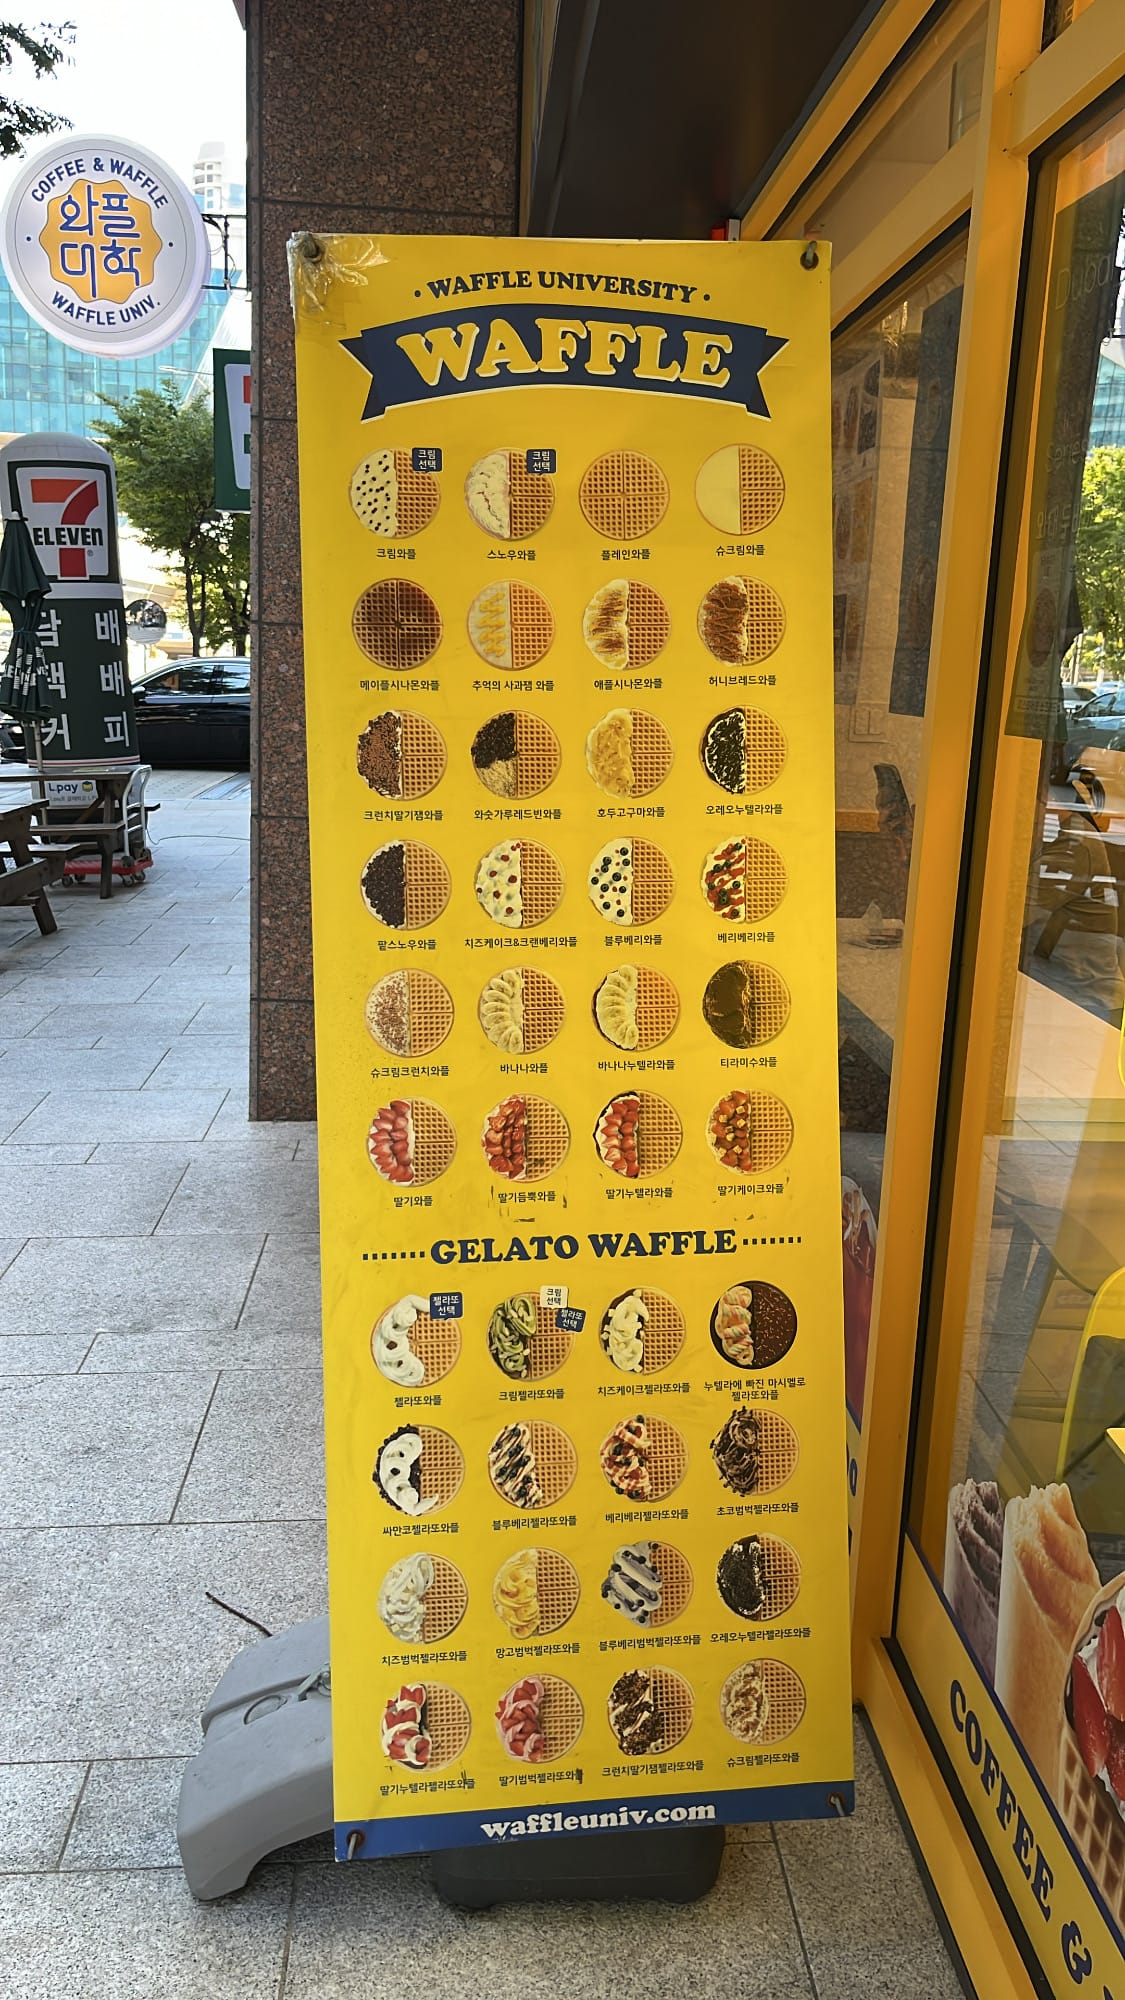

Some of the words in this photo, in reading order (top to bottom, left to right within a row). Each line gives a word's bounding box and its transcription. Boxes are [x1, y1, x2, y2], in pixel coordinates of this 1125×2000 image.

[31, 157, 86, 202] COFFEE
[93, 157, 104, 172] &
[110, 158, 169, 209] WAFFLE
[59, 184, 141, 238] 와플
[60, 239, 142, 298] 대학
[427, 270, 532, 299] WAFFLE
[538, 270, 698, 303] UNIVERSITY
[51, 291, 117, 326] WAFFLE
[119, 293, 161, 323] UNIV.
[396, 317, 733, 389] WAFFLE
[418, 449, 436, 459] 크림
[533, 451, 550, 461] 크림
[419, 459, 437, 470] 선택
[533, 461, 551, 472] 선택
[376, 548, 417, 560] 크림와플
[487, 549, 537, 561] 스노우와플
[601, 548, 651, 561] 플레인와플
[715, 544, 765, 557] 슈크림와플
[359, 679, 440, 691] 메이플시나몬와플
[472, 680, 502, 691] 추억의
[504, 680, 533, 691] 사과잼
[535, 680, 555, 691] 와플
[593, 678, 663, 691] 애플시나몬와플
[708, 675, 777, 687] 허니브레드와플
[41, 711, 130, 750] 커피
[363, 810, 444, 822] 크런치딸기잼와플
[596, 806, 665, 818] 호두고구마와플
[705, 804, 783, 816] 오레오누텔라와플
[605, 934, 663, 947] 블루베리와플
[717, 931, 775, 943] 베리베리와플
[377, 939, 436, 951] 팥스노우와플
[500, 1062, 549, 1075] 바나나와플
[598, 1059, 675, 1072] 바나나누텔라와플
[720, 1056, 777, 1068] 티라미수와플
[371, 1065, 450, 1078] 슈크림크런치와플
[497, 1189, 557, 1204] 딸기듬뿍와플
[605, 1187, 673, 1200] 딸기누텔라와플
[717, 1183, 785, 1197] 딸기케이크와플
[393, 1195, 433, 1208] 딸기와플
[430, 1234, 580, 1265] GELATO
[588, 1229, 738, 1259] WAFFLE
[546, 1288, 562, 1297] 크림
[432, 1294, 460, 1306] 젤라또
[546, 1296, 562, 1306] 선택
[437, 1305, 456, 1316] 선택
[559, 1307, 583, 1320] 젤라또
[561, 1317, 577, 1329] 선택
[597, 1382, 690, 1397] 치즈케이크젤라또와플
[704, 1379, 742, 1391] 누텔라에
[745, 1378, 764, 1390] 빠진
[767, 1377, 806, 1389] 마시멜로
[394, 1394, 442, 1408] 젤라또와플
[499, 1388, 565, 1402] 크림젤라또와플
[731, 1389, 779, 1402] 젤라또와플
[716, 1502, 800, 1516] 초코범벅젤라또와플
[605, 1508, 689, 1524] 베리베리젤라또와플
[382, 1522, 459, 1537] 싸만코젤라또와플
[492, 1515, 577, 1531] 블루베리젤라또와플
[710, 1627, 812, 1643] 오레오누텔라젤라또와플
[599, 1634, 702, 1652] 블루베리범벅젤라또와플
[495, 1643, 581, 1659] 망고범벅젤라또와플
[382, 1650, 468, 1666] 치즈범벅젤라또와플
[726, 1752, 801, 1768] 슈크림젤라또와플
[601, 1759, 705, 1779] 크런치딸기잼젤라또와플
[950, 1679, 1054, 1922] COFFEE
[480, 1801, 717, 1840] waffleuniv.com
